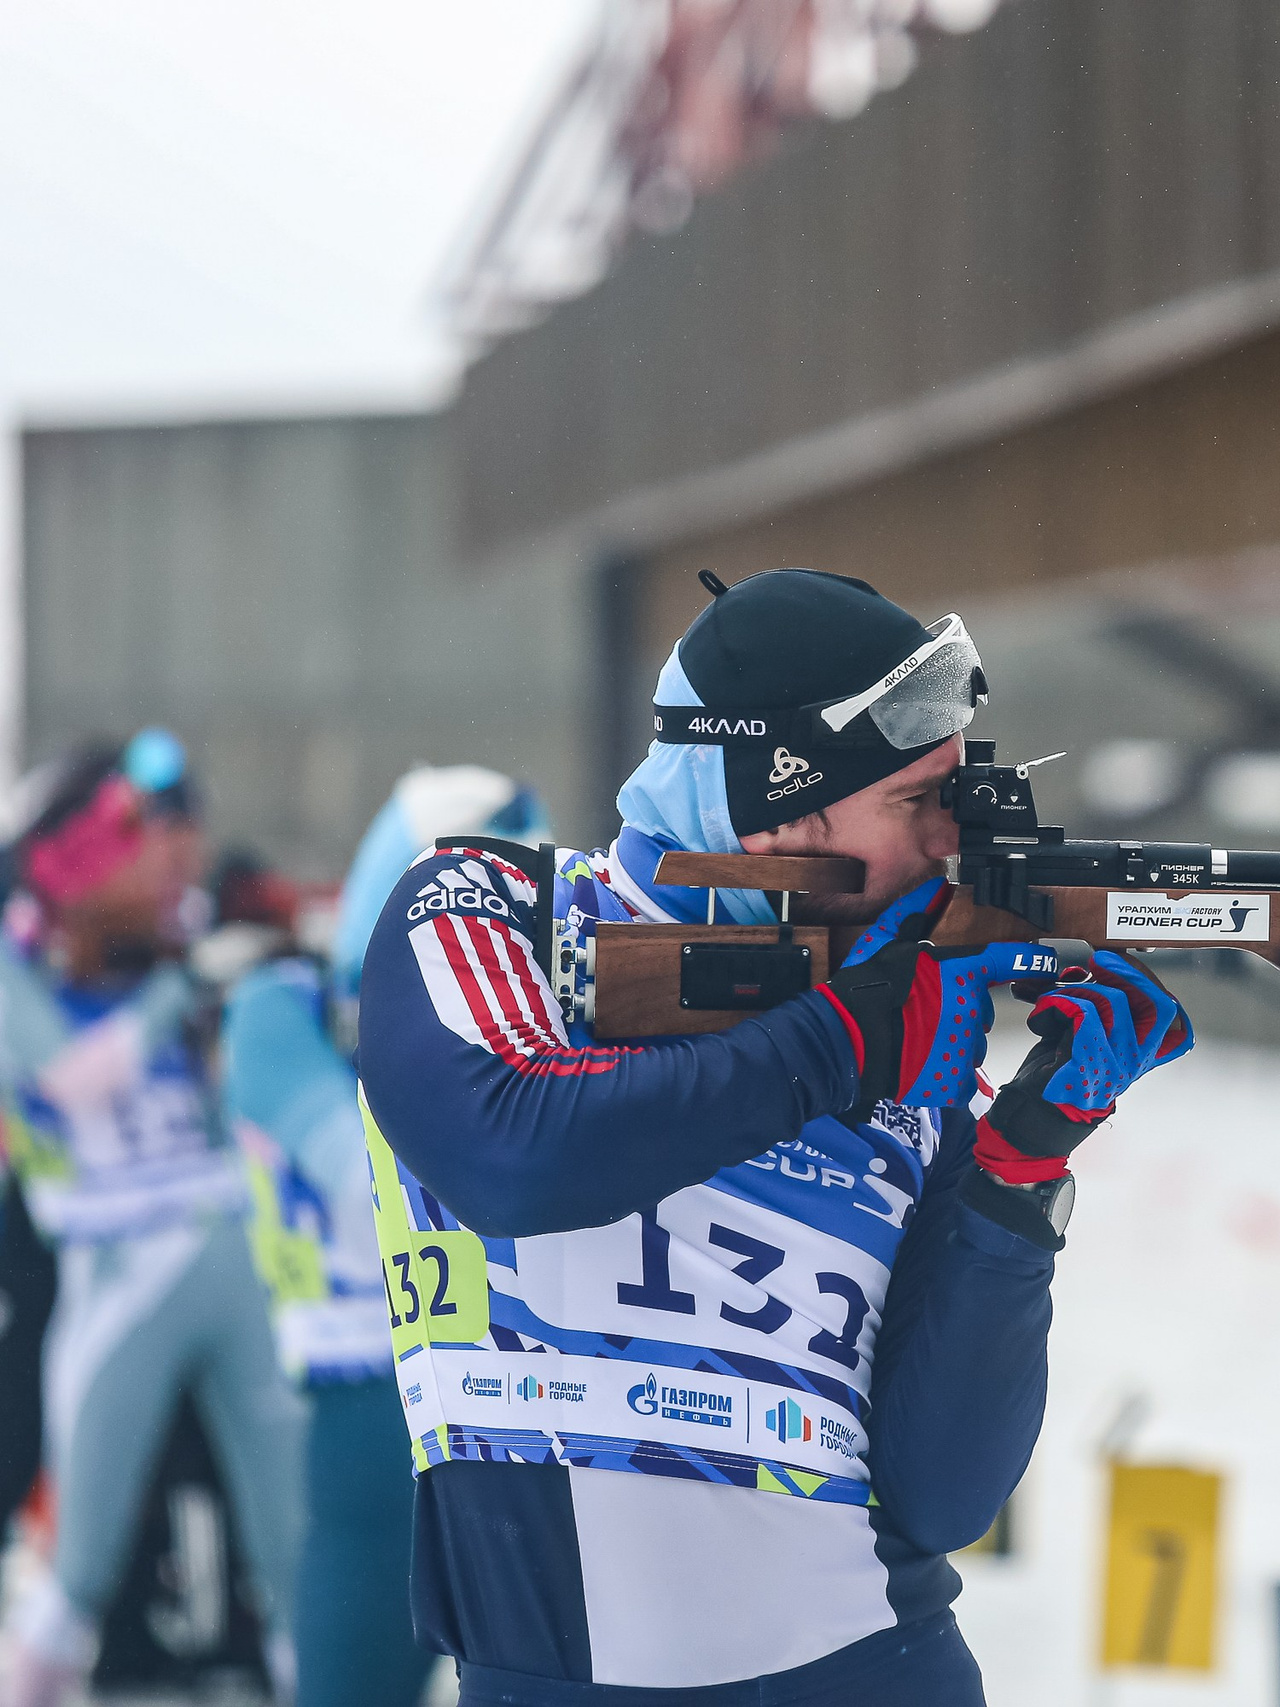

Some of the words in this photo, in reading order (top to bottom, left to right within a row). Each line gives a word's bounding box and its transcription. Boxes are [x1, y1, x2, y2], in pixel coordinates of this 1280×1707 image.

[766, 771, 823, 801] odlo
[1160, 864, 1205, 872] ПИОНЕР
[407, 888, 521, 922] adida
[1117, 905, 1172, 914] УРАЛХИМ
[1117, 916, 1183, 927] PIONER
[1186, 918, 1223, 928] CUP
[744, 1150, 855, 1189] CUP
[549, 1381, 587, 1393] РОДНЫЕ
[549, 1391, 584, 1403] ГОРОДА
[661, 1386, 732, 1413] ГАЗПРОМ
